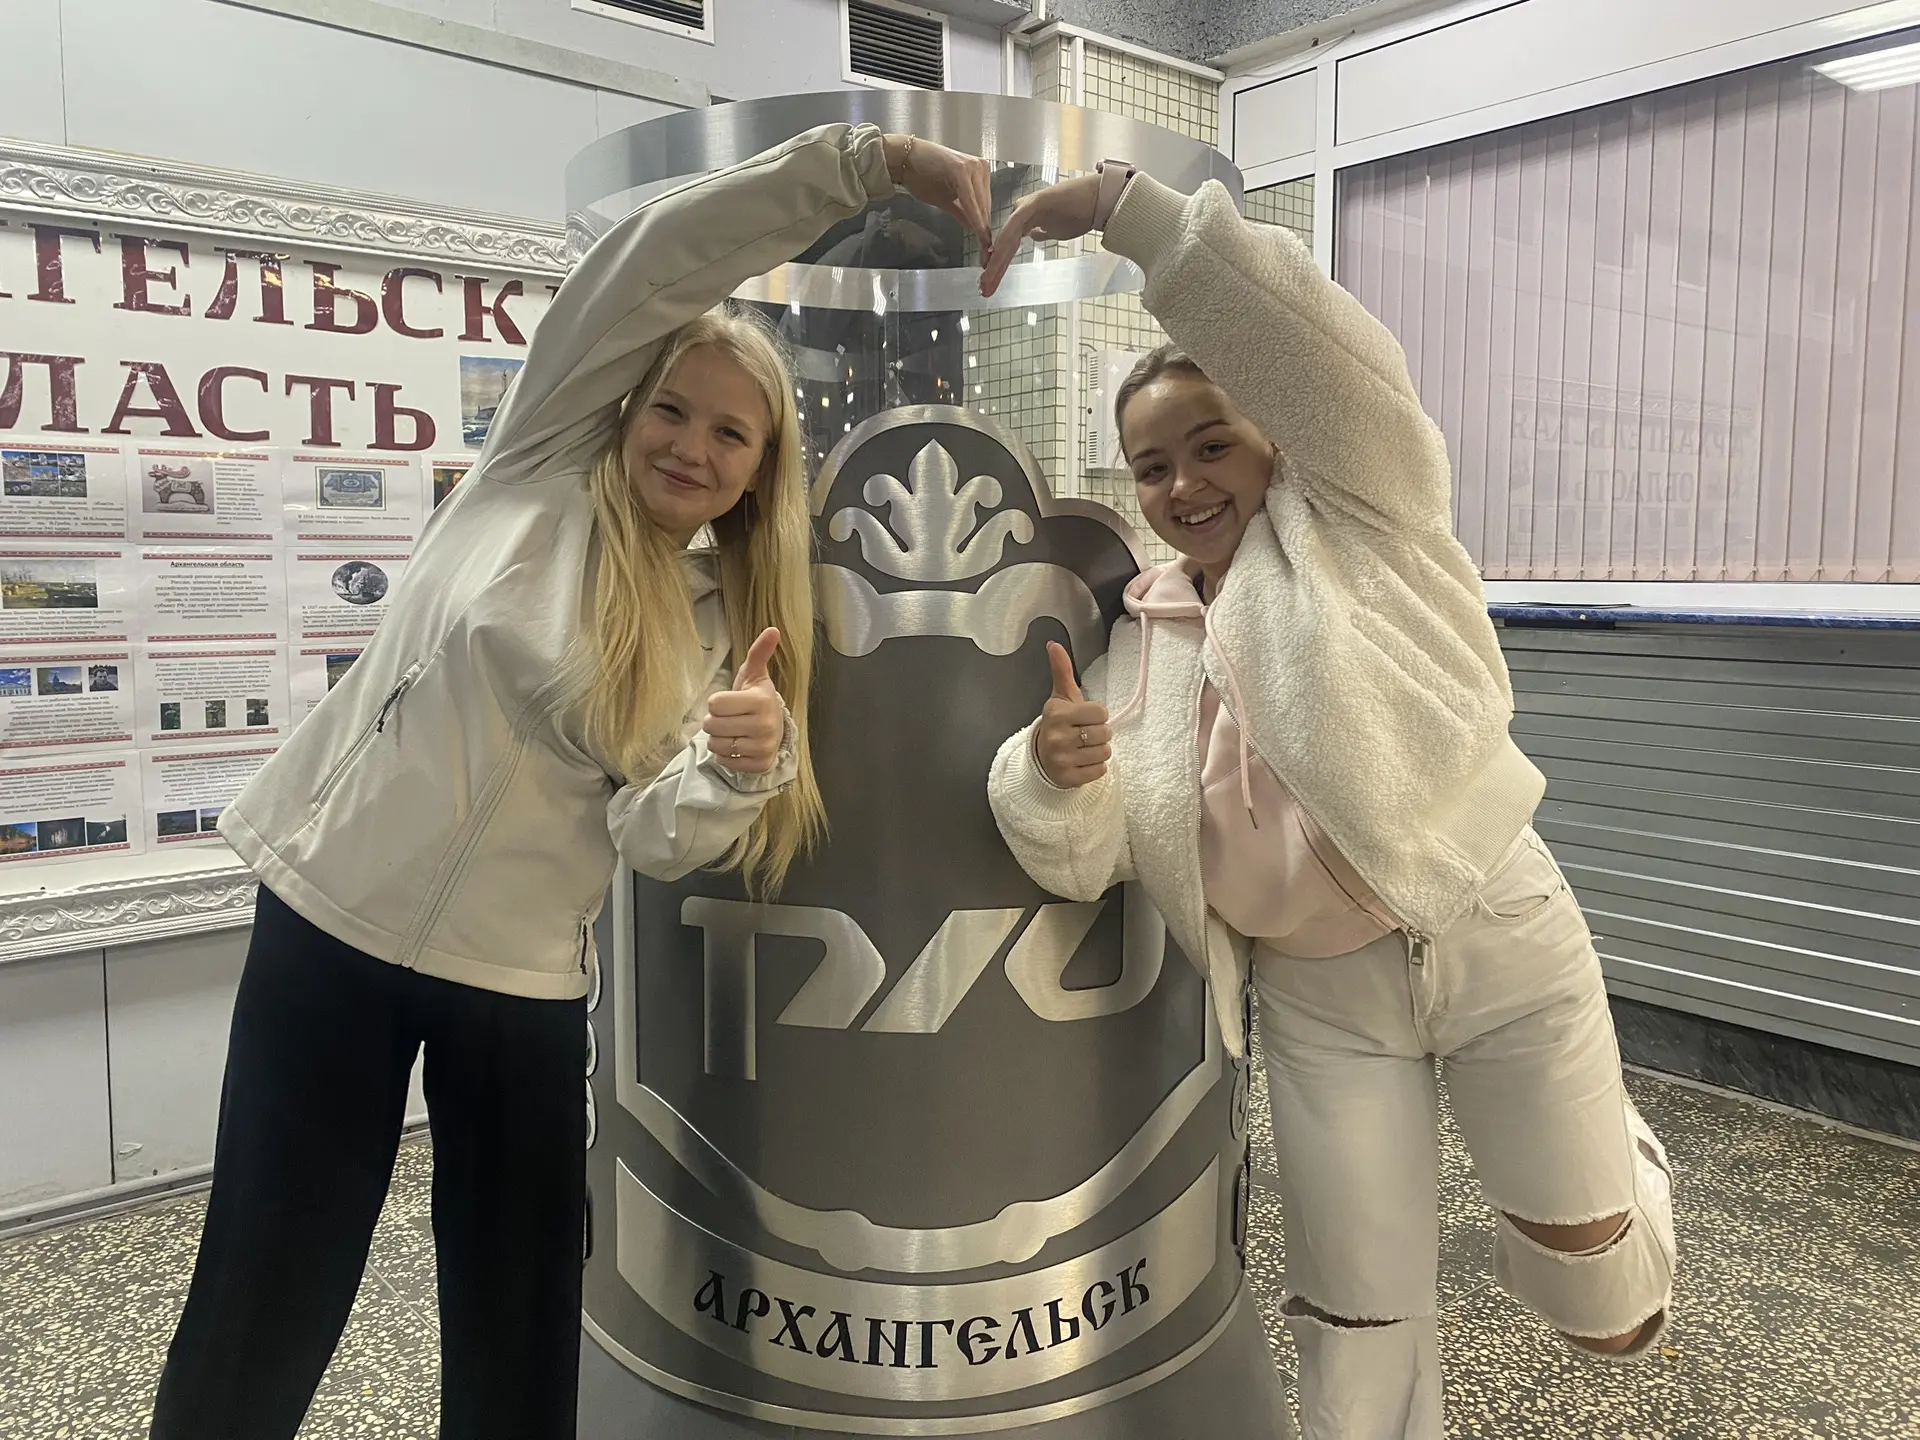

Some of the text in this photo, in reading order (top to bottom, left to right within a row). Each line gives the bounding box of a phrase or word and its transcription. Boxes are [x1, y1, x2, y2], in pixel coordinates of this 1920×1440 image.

[0, 218, 558, 346] ГЕЛЬСК
[170, 561, 219, 569] Архангельская
[692, 1257, 1151, 1369] АРХАНГЕЛЬСК
